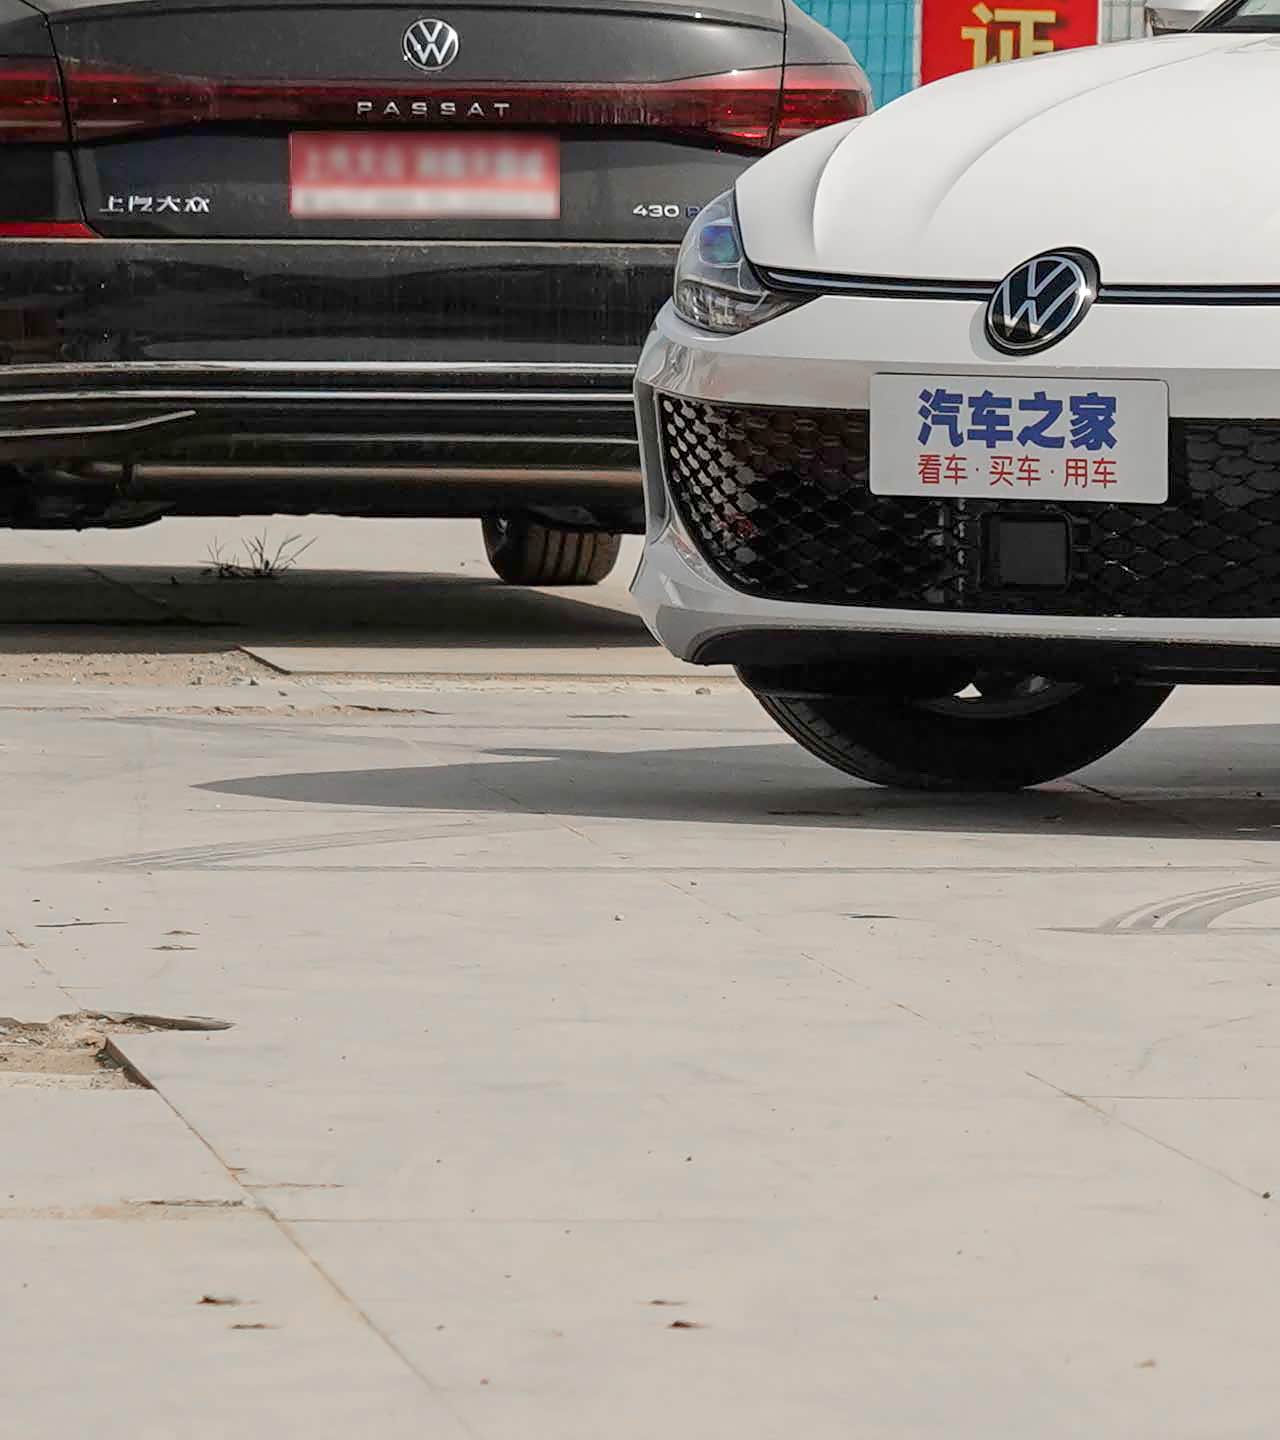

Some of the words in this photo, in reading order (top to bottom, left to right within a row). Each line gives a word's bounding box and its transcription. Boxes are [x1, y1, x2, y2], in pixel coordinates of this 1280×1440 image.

[357, 102, 511, 116] PASSAT
[632, 204, 680, 218] 430
[917, 388, 1119, 452] 汽车之家
